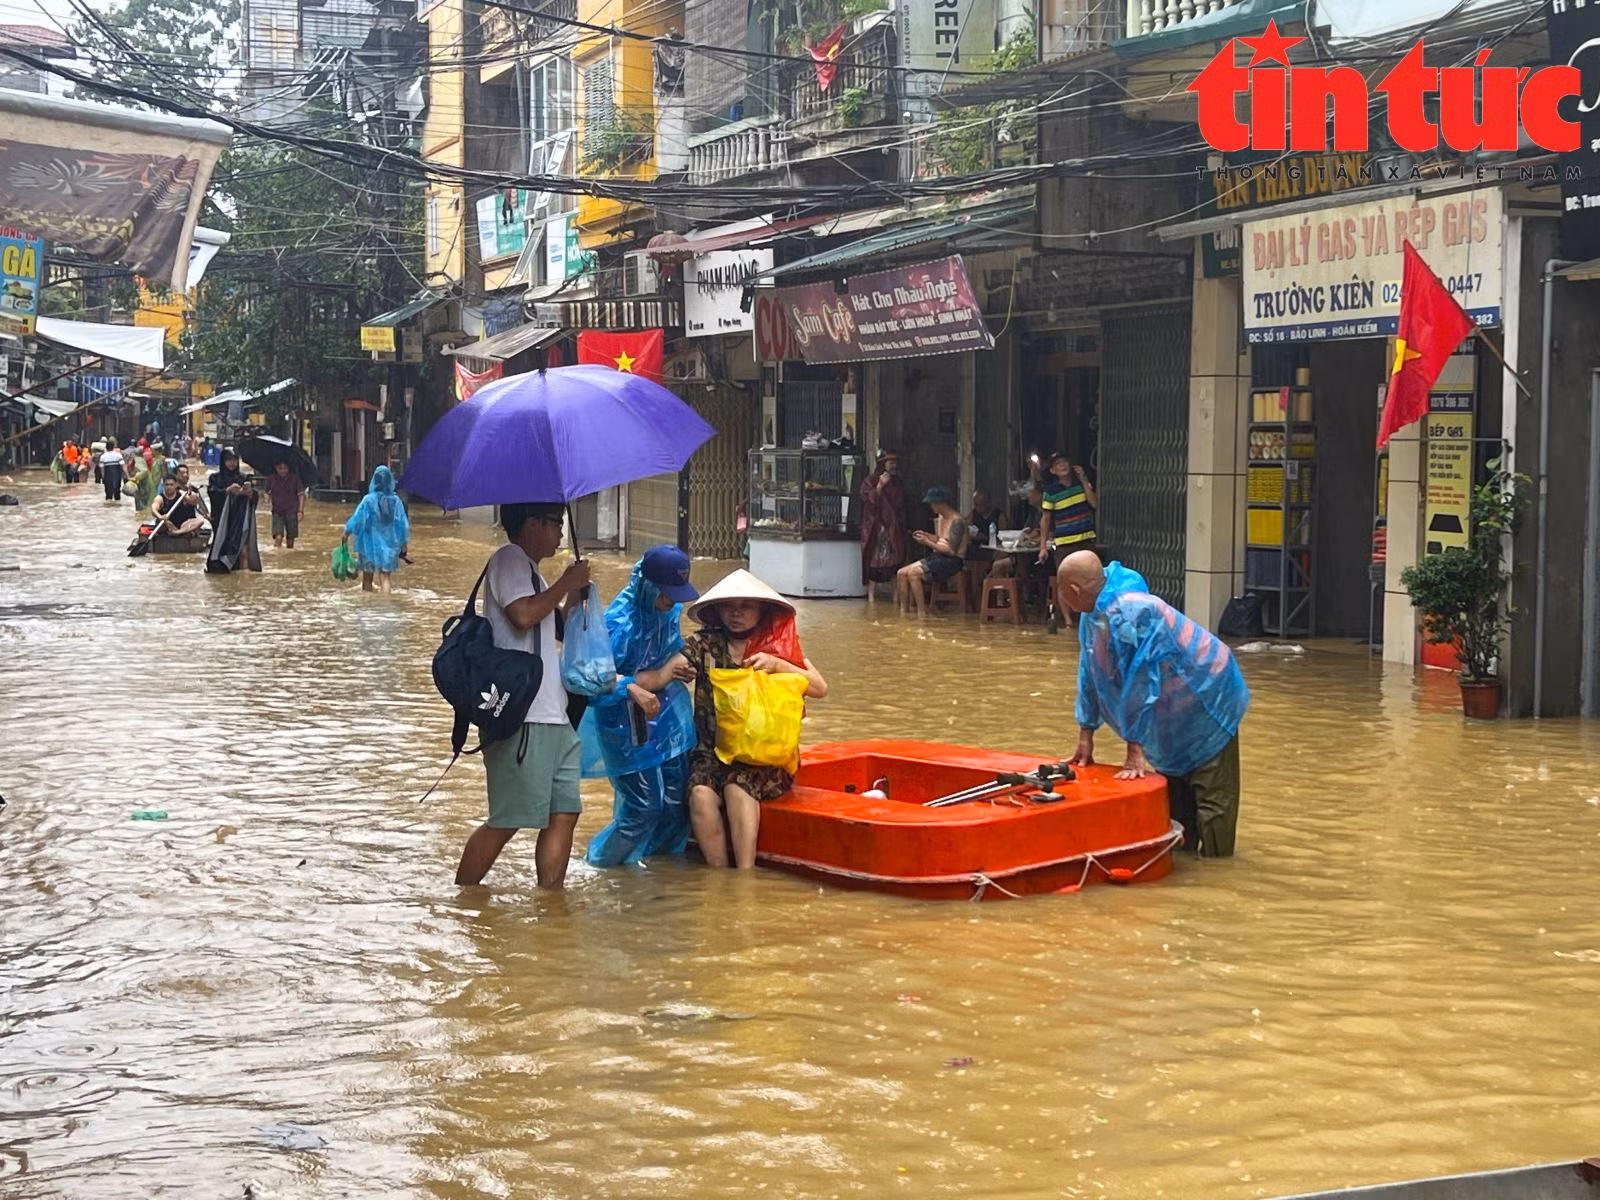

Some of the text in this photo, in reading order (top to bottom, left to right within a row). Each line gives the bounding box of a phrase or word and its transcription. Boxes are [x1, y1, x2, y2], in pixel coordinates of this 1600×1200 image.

[1253, 228, 1285, 278] ĐẠI
[1290, 217, 1311, 267] LÝ
[1317, 217, 1357, 263] GAS
[1361, 205, 1389, 257] VÀ
[1442, 199, 1487, 248] GAS
[3, 242, 36, 279] GÀ
[850, 293, 873, 312] Hát
[872, 291, 894, 309] Cho
[1253, 281, 1325, 319] TRƯỜNG
[1329, 273, 1375, 312] KIÊN
[1263, 328, 1274, 342] SỐ
[493, 692, 511, 718] adidas
